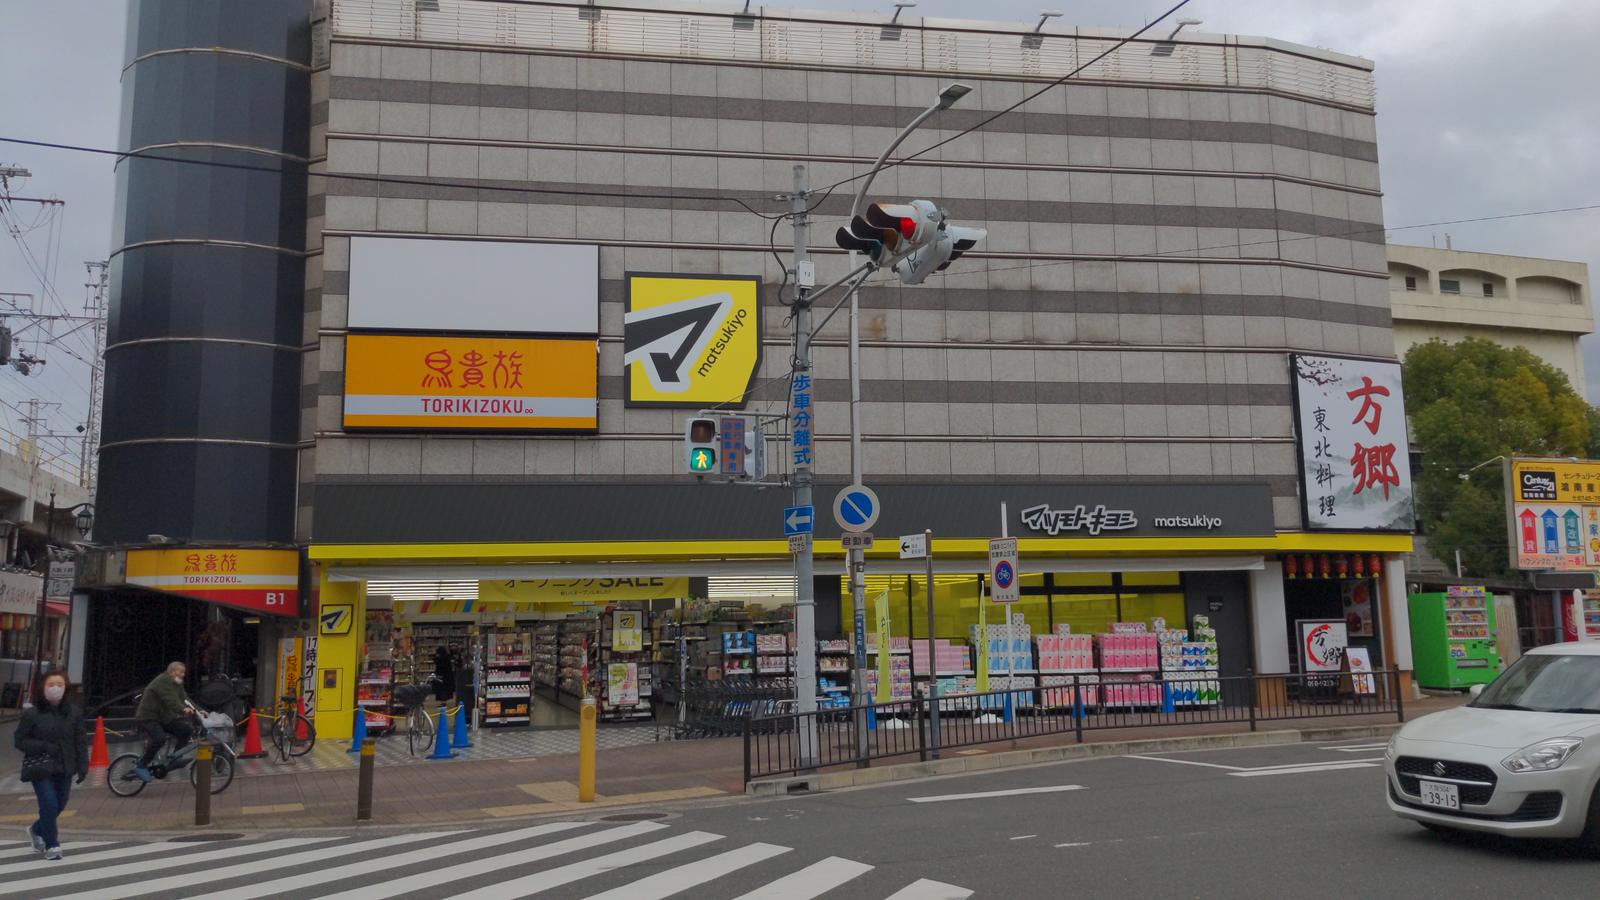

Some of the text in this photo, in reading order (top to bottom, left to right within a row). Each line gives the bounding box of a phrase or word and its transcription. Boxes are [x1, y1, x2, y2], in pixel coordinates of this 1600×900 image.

[697, 307, 748, 378] matsukiyo
[421, 348, 524, 390] 鳥貴族
[421, 397, 524, 414] TORIKIZOKU
[793, 374, 811, 466] 歩車分離式
[1346, 376, 1400, 502] 方郷
[1313, 406, 1337, 517] 東北料理
[1022, 504, 1138, 535] マツモトキヨシ
[1154, 514, 1223, 530] matsukiyo
[842, 536, 872, 546] 自動車
[183, 553, 239, 572] 鳥貴族
[183, 575, 237, 584] TORIKIZOKU
[265, 592, 286, 606] B1
[1429, 791, 1457, 807] 39-15
